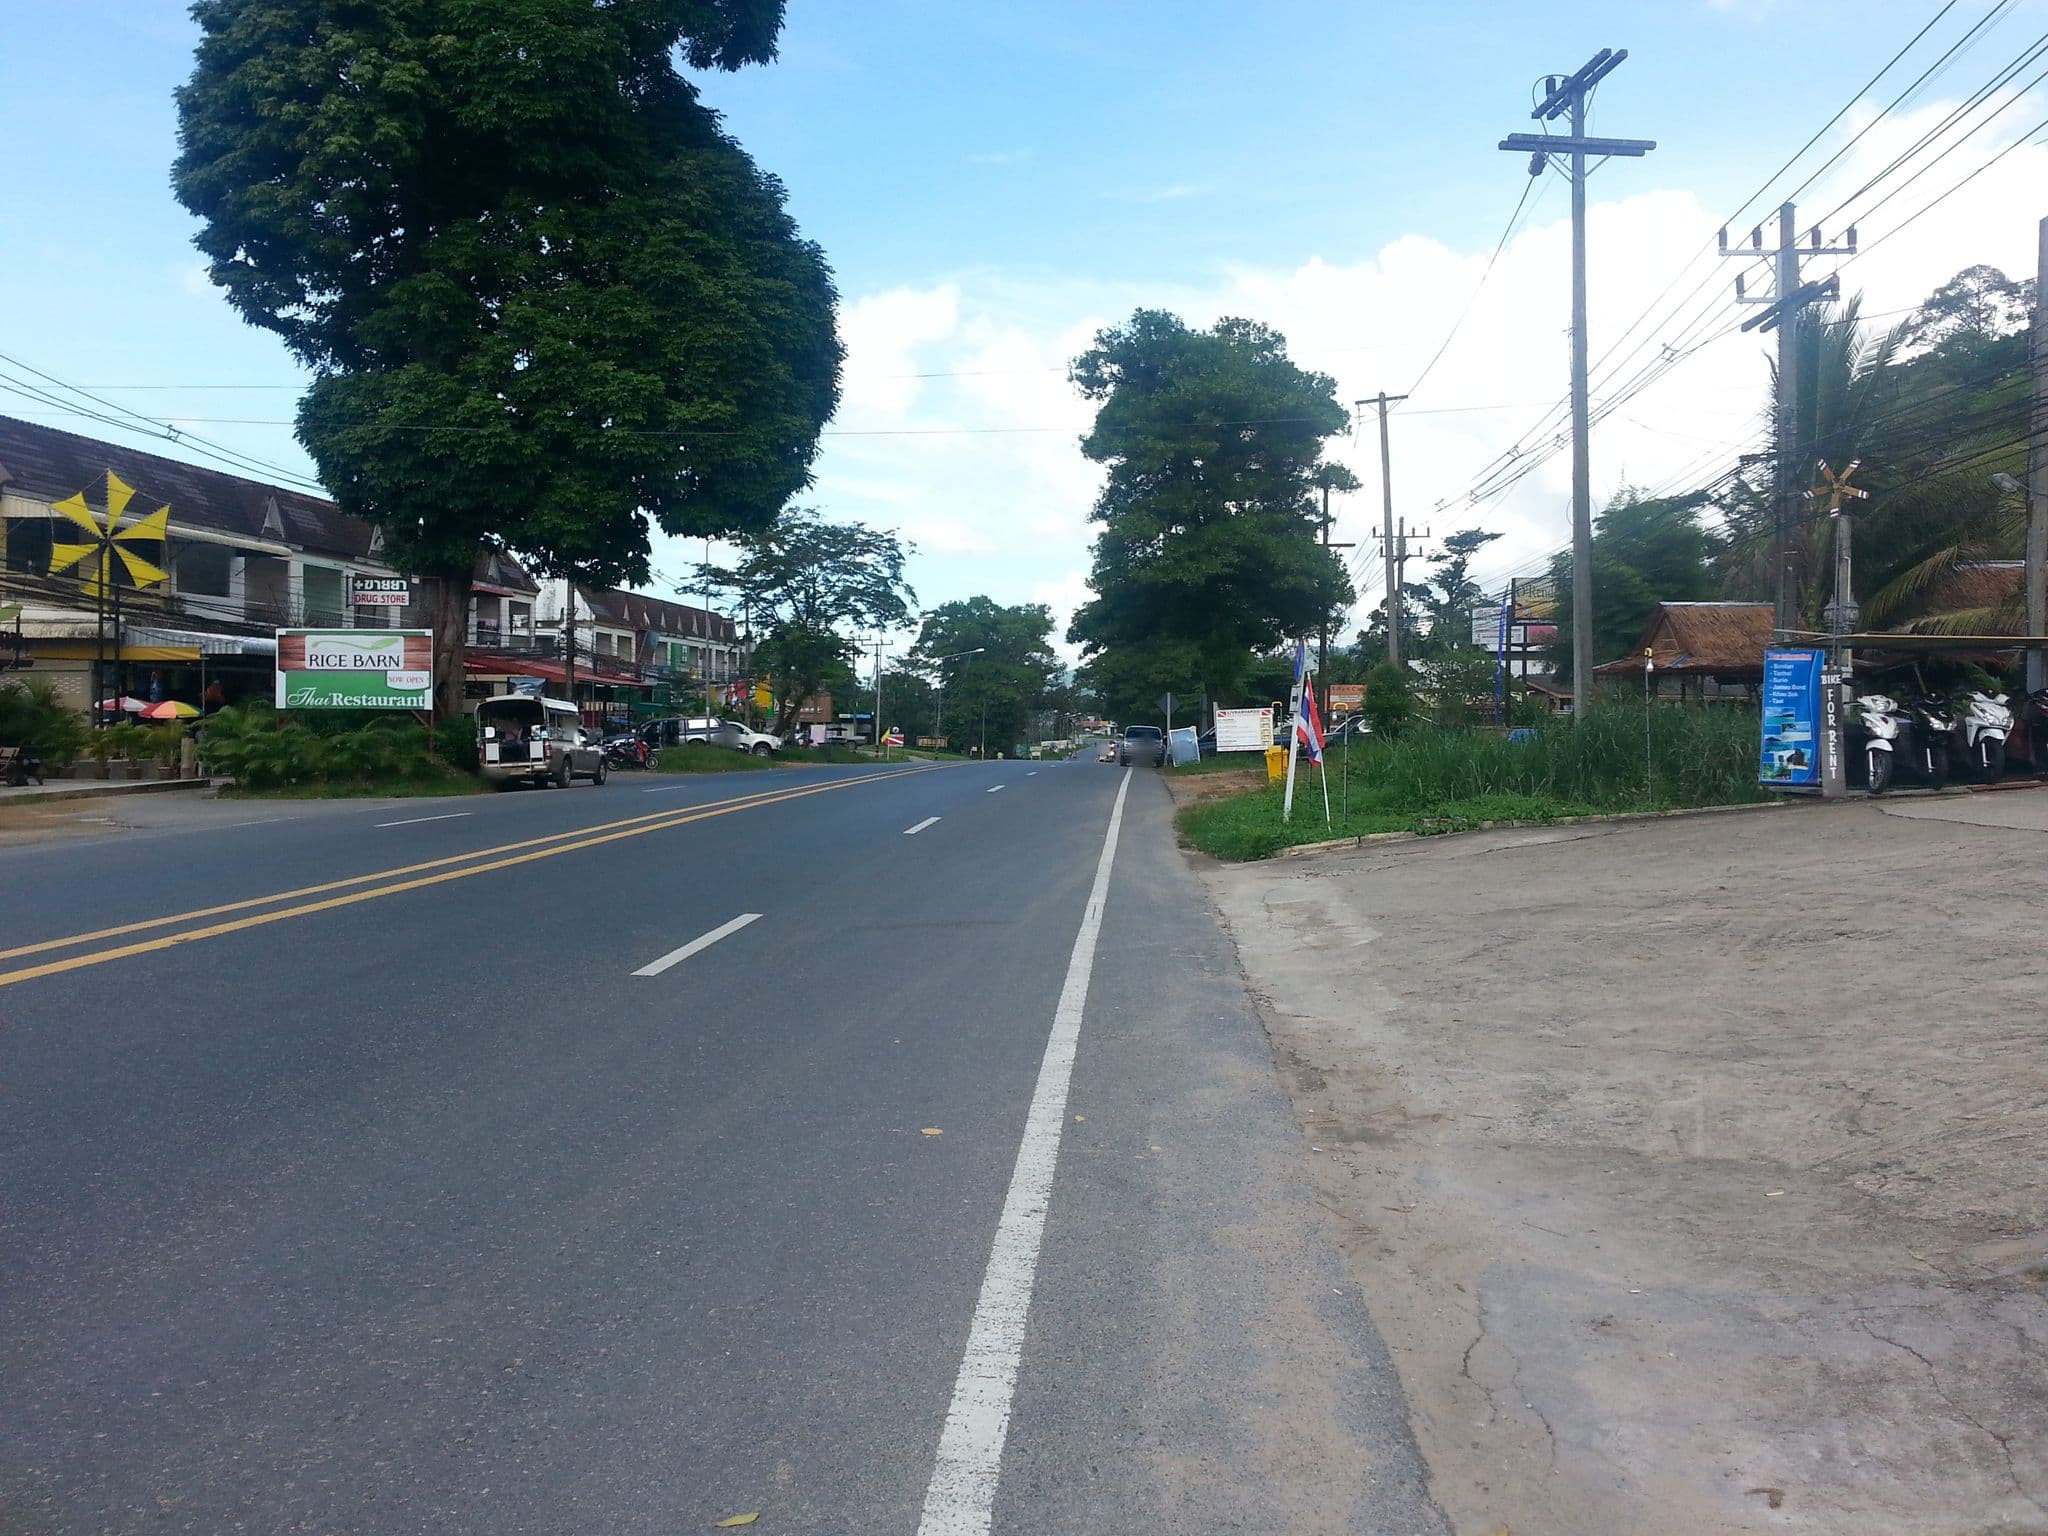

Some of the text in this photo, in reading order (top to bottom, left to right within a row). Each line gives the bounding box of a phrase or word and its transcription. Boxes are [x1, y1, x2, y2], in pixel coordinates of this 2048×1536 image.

[364, 579, 407, 590] ขายยา
[354, 594, 406, 603] DRUG STORE
[309, 654, 400, 668] RICE BARN
[388, 676, 424, 684] NOW OPEN
[1820, 674, 1841, 685] BIKE
[287, 687, 425, 707] Thai Restaurant
[1827, 688, 1837, 727] FOR
[1828, 729, 1838, 780] RENT
